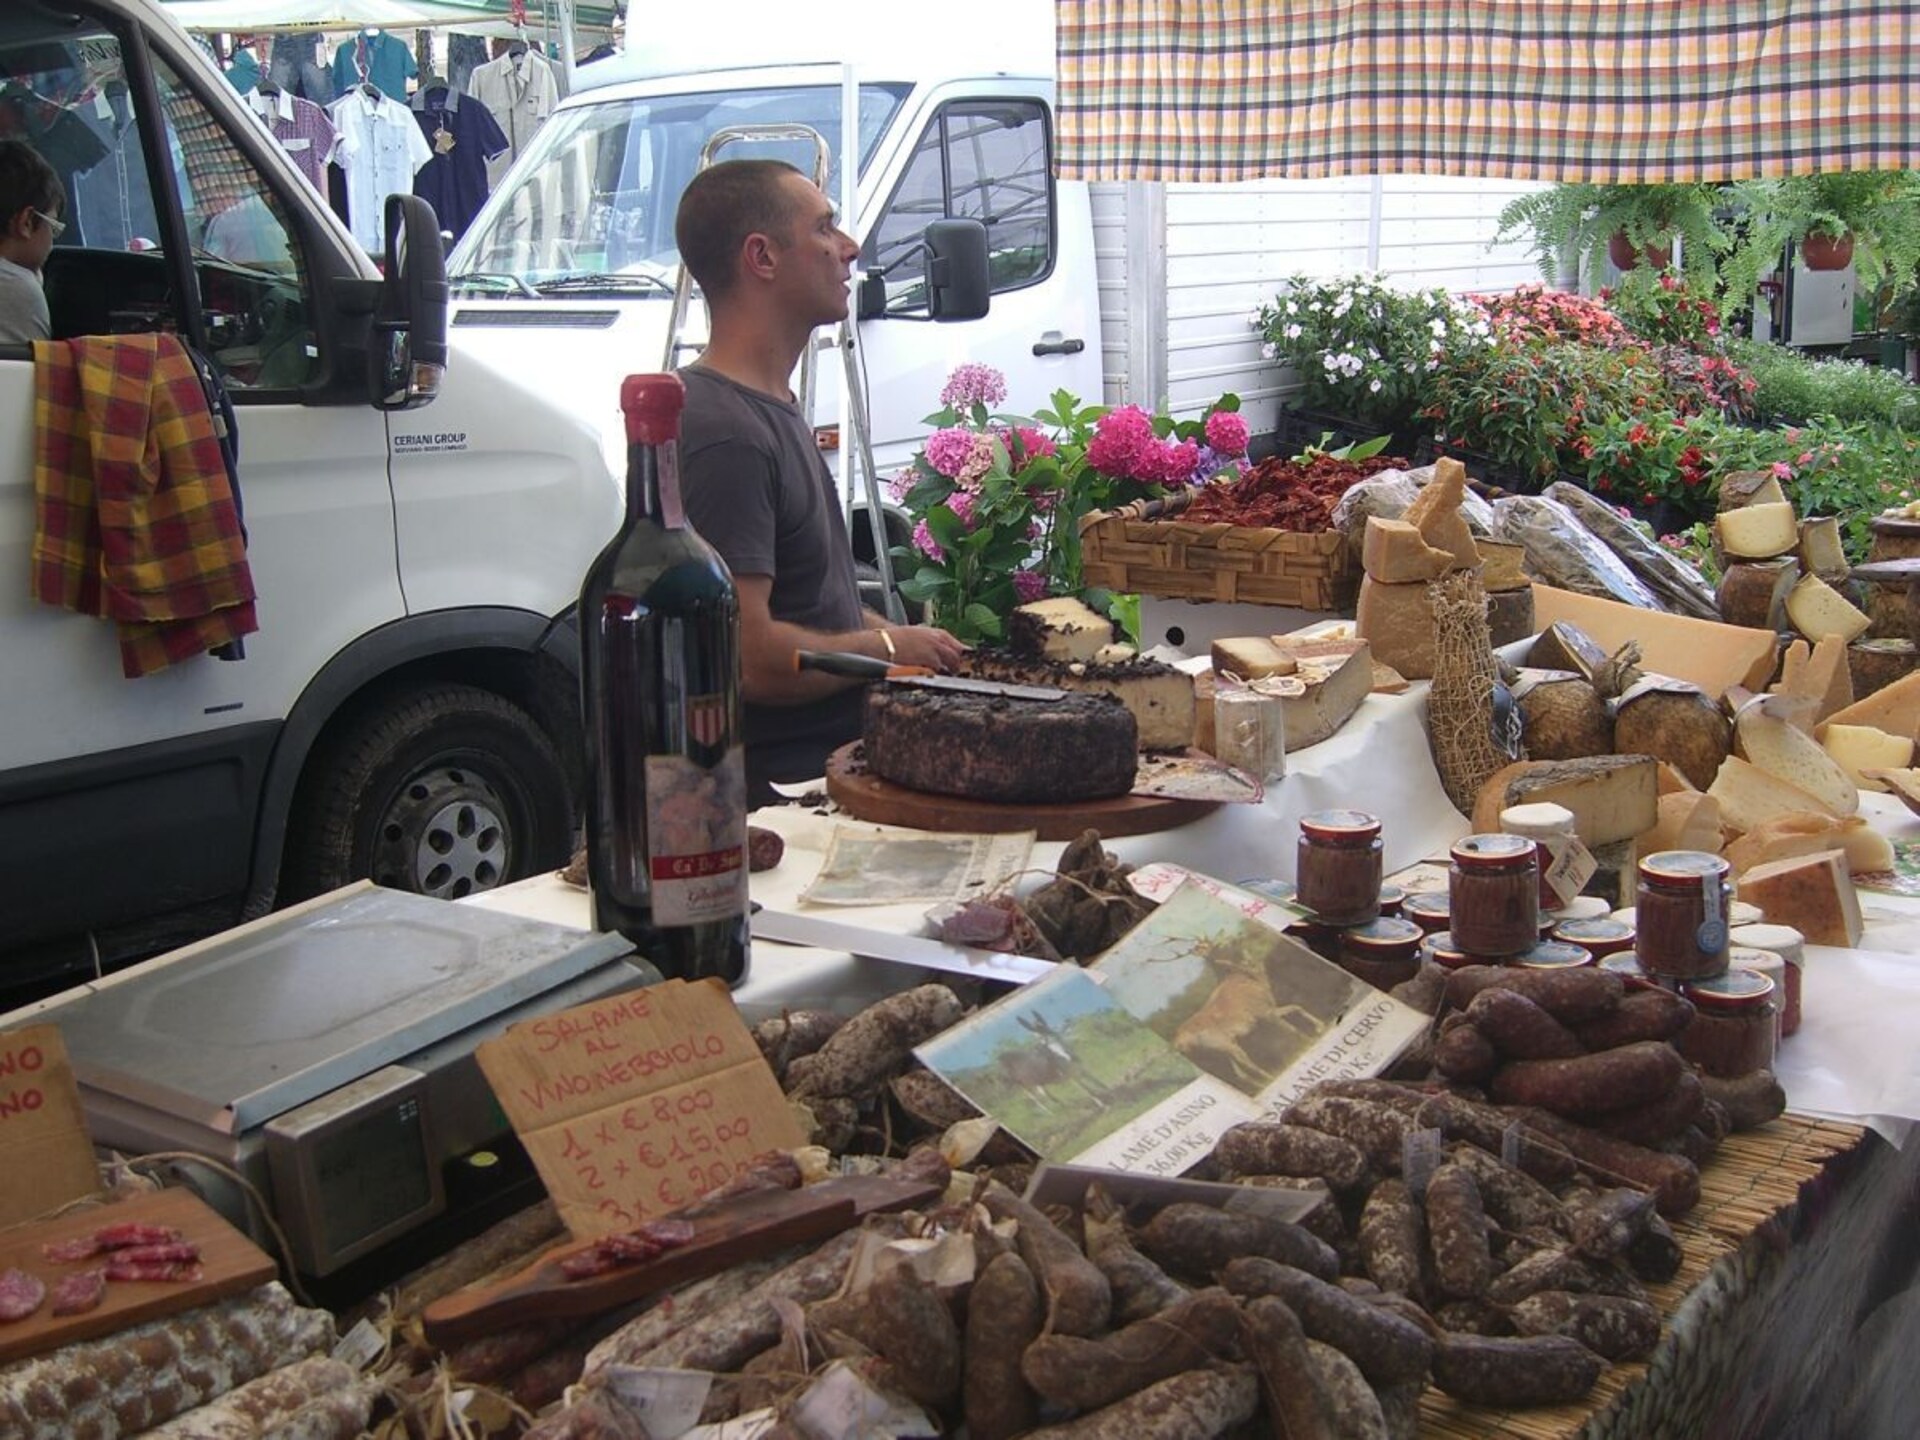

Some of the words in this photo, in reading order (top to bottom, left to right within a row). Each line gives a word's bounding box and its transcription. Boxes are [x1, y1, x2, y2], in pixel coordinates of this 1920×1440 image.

[394, 434, 433, 446] CERIANI
[434, 433, 467, 444] GROUP
[531, 998, 652, 1053] SALAME
[584, 1036, 622, 1057] AL
[520, 1073, 592, 1111] VINO
[593, 1034, 726, 1093] NEBBIOLO
[1263, 1060, 1331, 1122] SALAME
[1322, 1044, 1348, 1065] DI
[1342, 999, 1396, 1047] CERVO
[1107, 1133, 1162, 1174] LAME
[1152, 1093, 1218, 1141] D'ASINO
[1180, 1131, 1214, 1152] Kg
[577, 1164, 606, 1190] 2
[598, 1198, 633, 1225] 3
